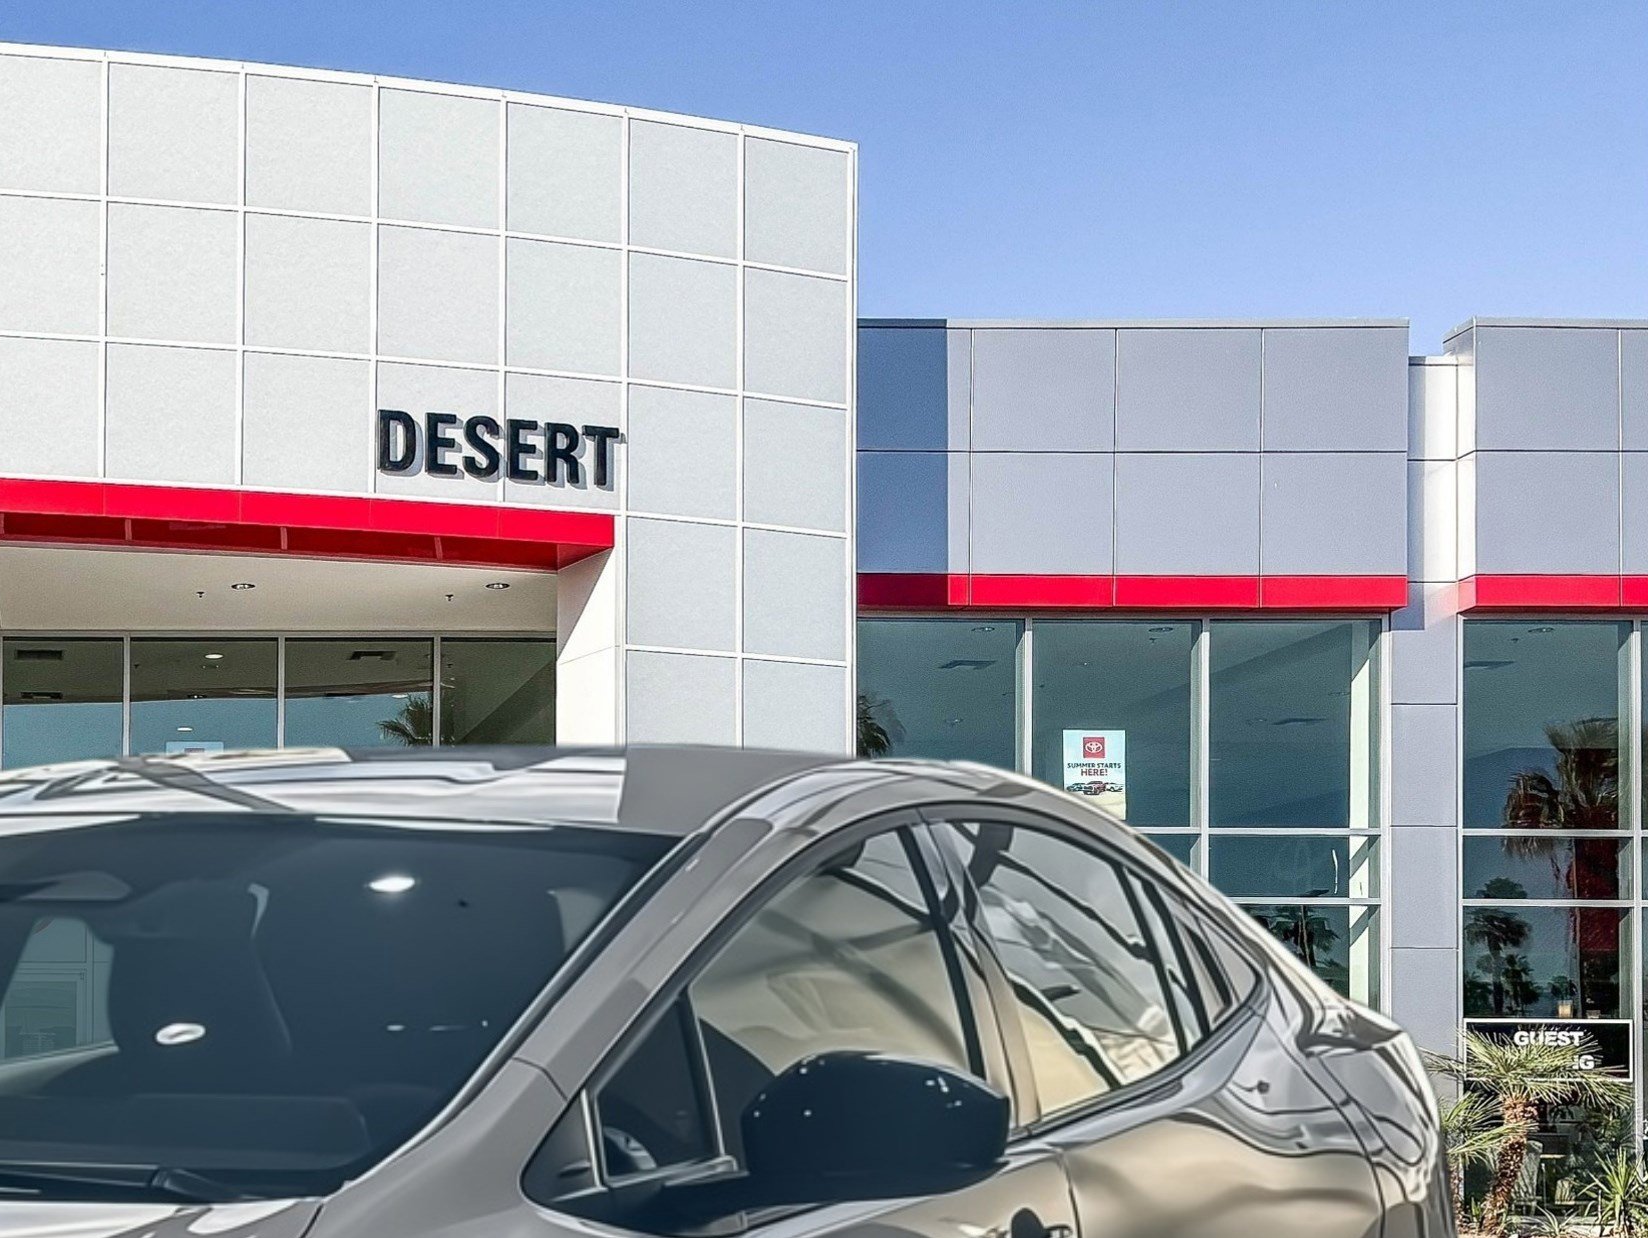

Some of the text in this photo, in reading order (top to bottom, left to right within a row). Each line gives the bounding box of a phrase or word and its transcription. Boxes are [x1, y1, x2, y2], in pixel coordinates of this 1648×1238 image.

[377, 409, 620, 487] DESERT
[1080, 768, 1108, 777] HERE!
[1513, 1030, 1585, 1047] GUEST
